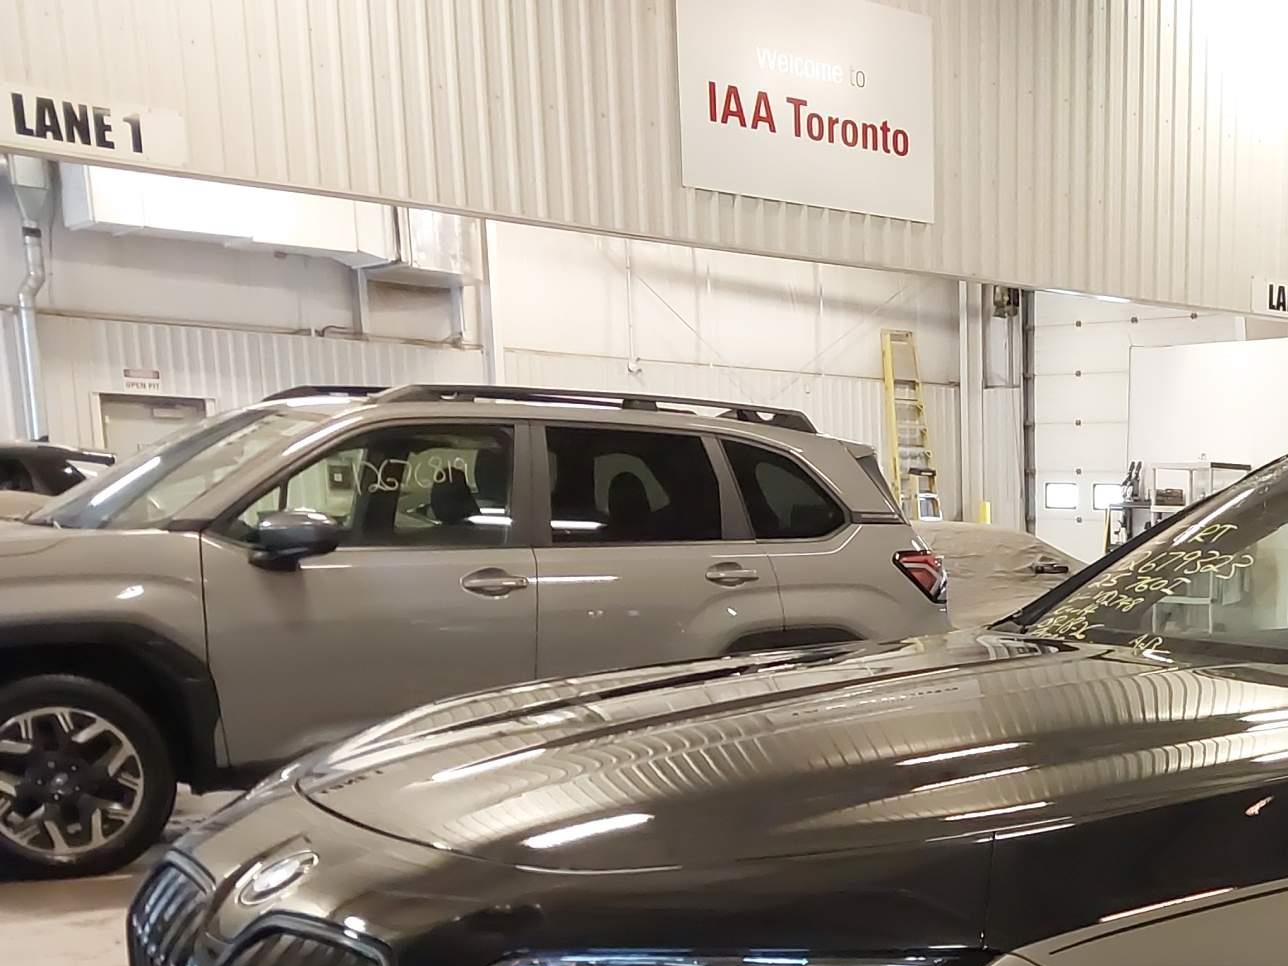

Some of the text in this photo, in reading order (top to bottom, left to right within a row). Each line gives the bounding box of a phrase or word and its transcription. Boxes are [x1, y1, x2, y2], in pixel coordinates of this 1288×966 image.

[756, 47, 866, 88] Welcome to
[11, 91, 144, 154] LANE 1
[708, 80, 910, 157] IAA Toronto
